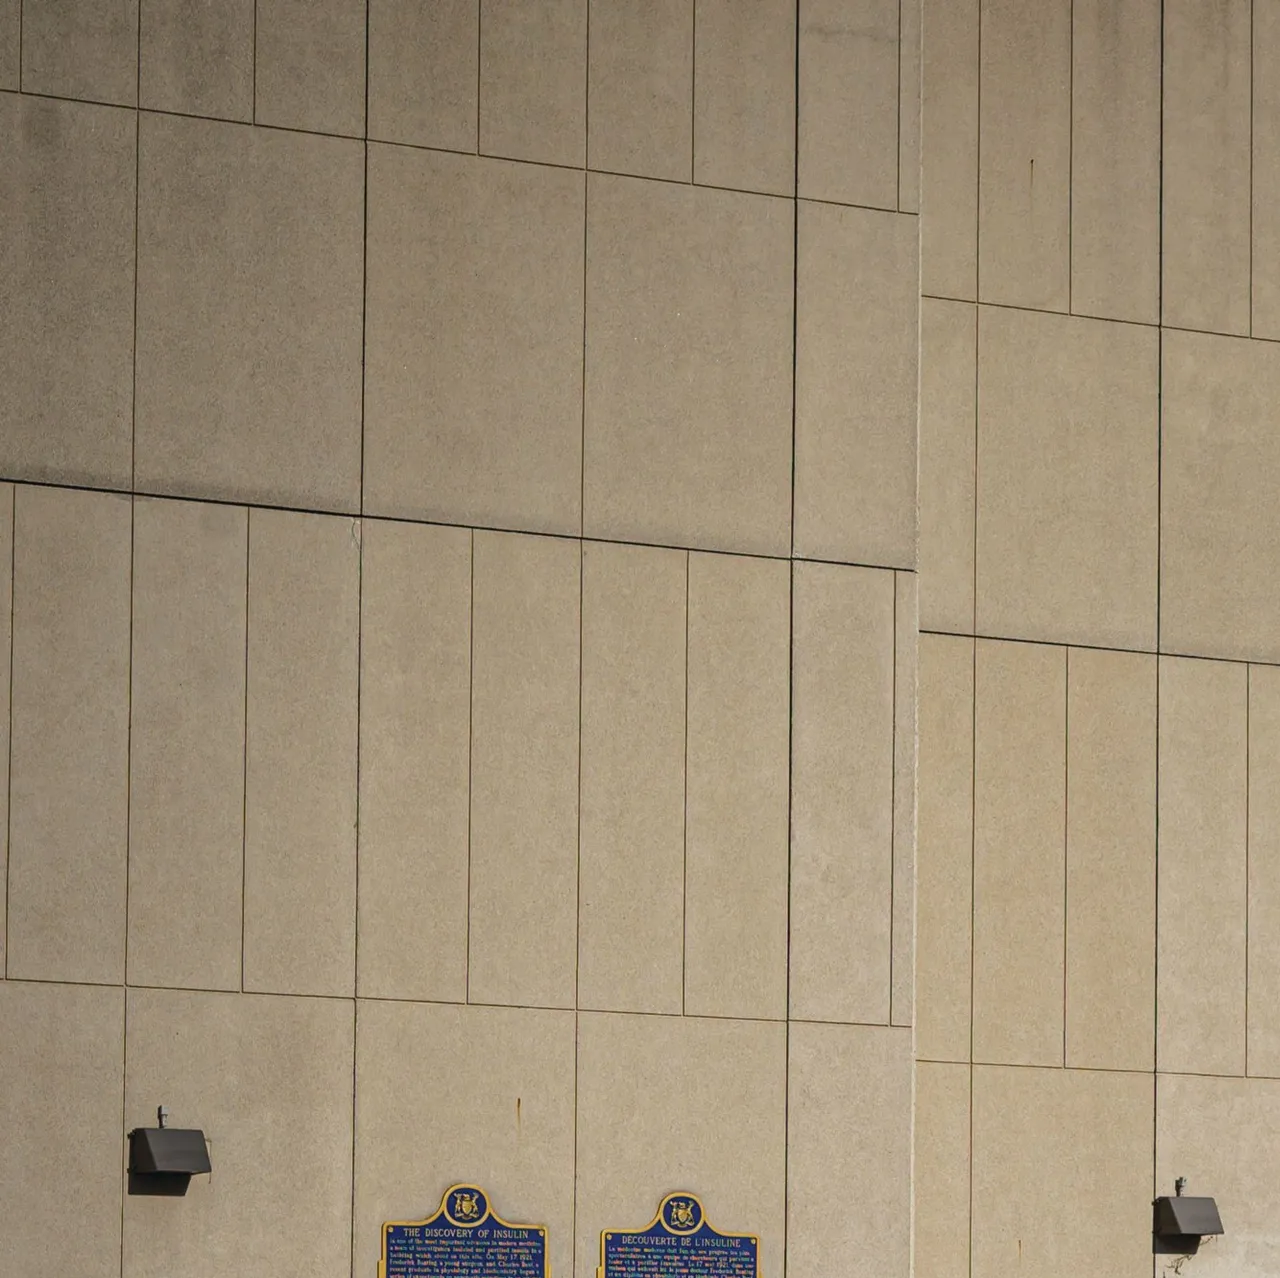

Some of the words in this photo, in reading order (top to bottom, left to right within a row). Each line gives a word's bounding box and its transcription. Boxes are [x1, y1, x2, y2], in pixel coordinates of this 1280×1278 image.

[403, 1227, 420, 1237] THE
[425, 1228, 473, 1238] DISCOVERY
[477, 1229, 489, 1238] OF
[493, 1229, 528, 1239] INSULIN
[681, 1236, 691, 1246] DE
[694, 1237, 740, 1247] L'INSULINE
